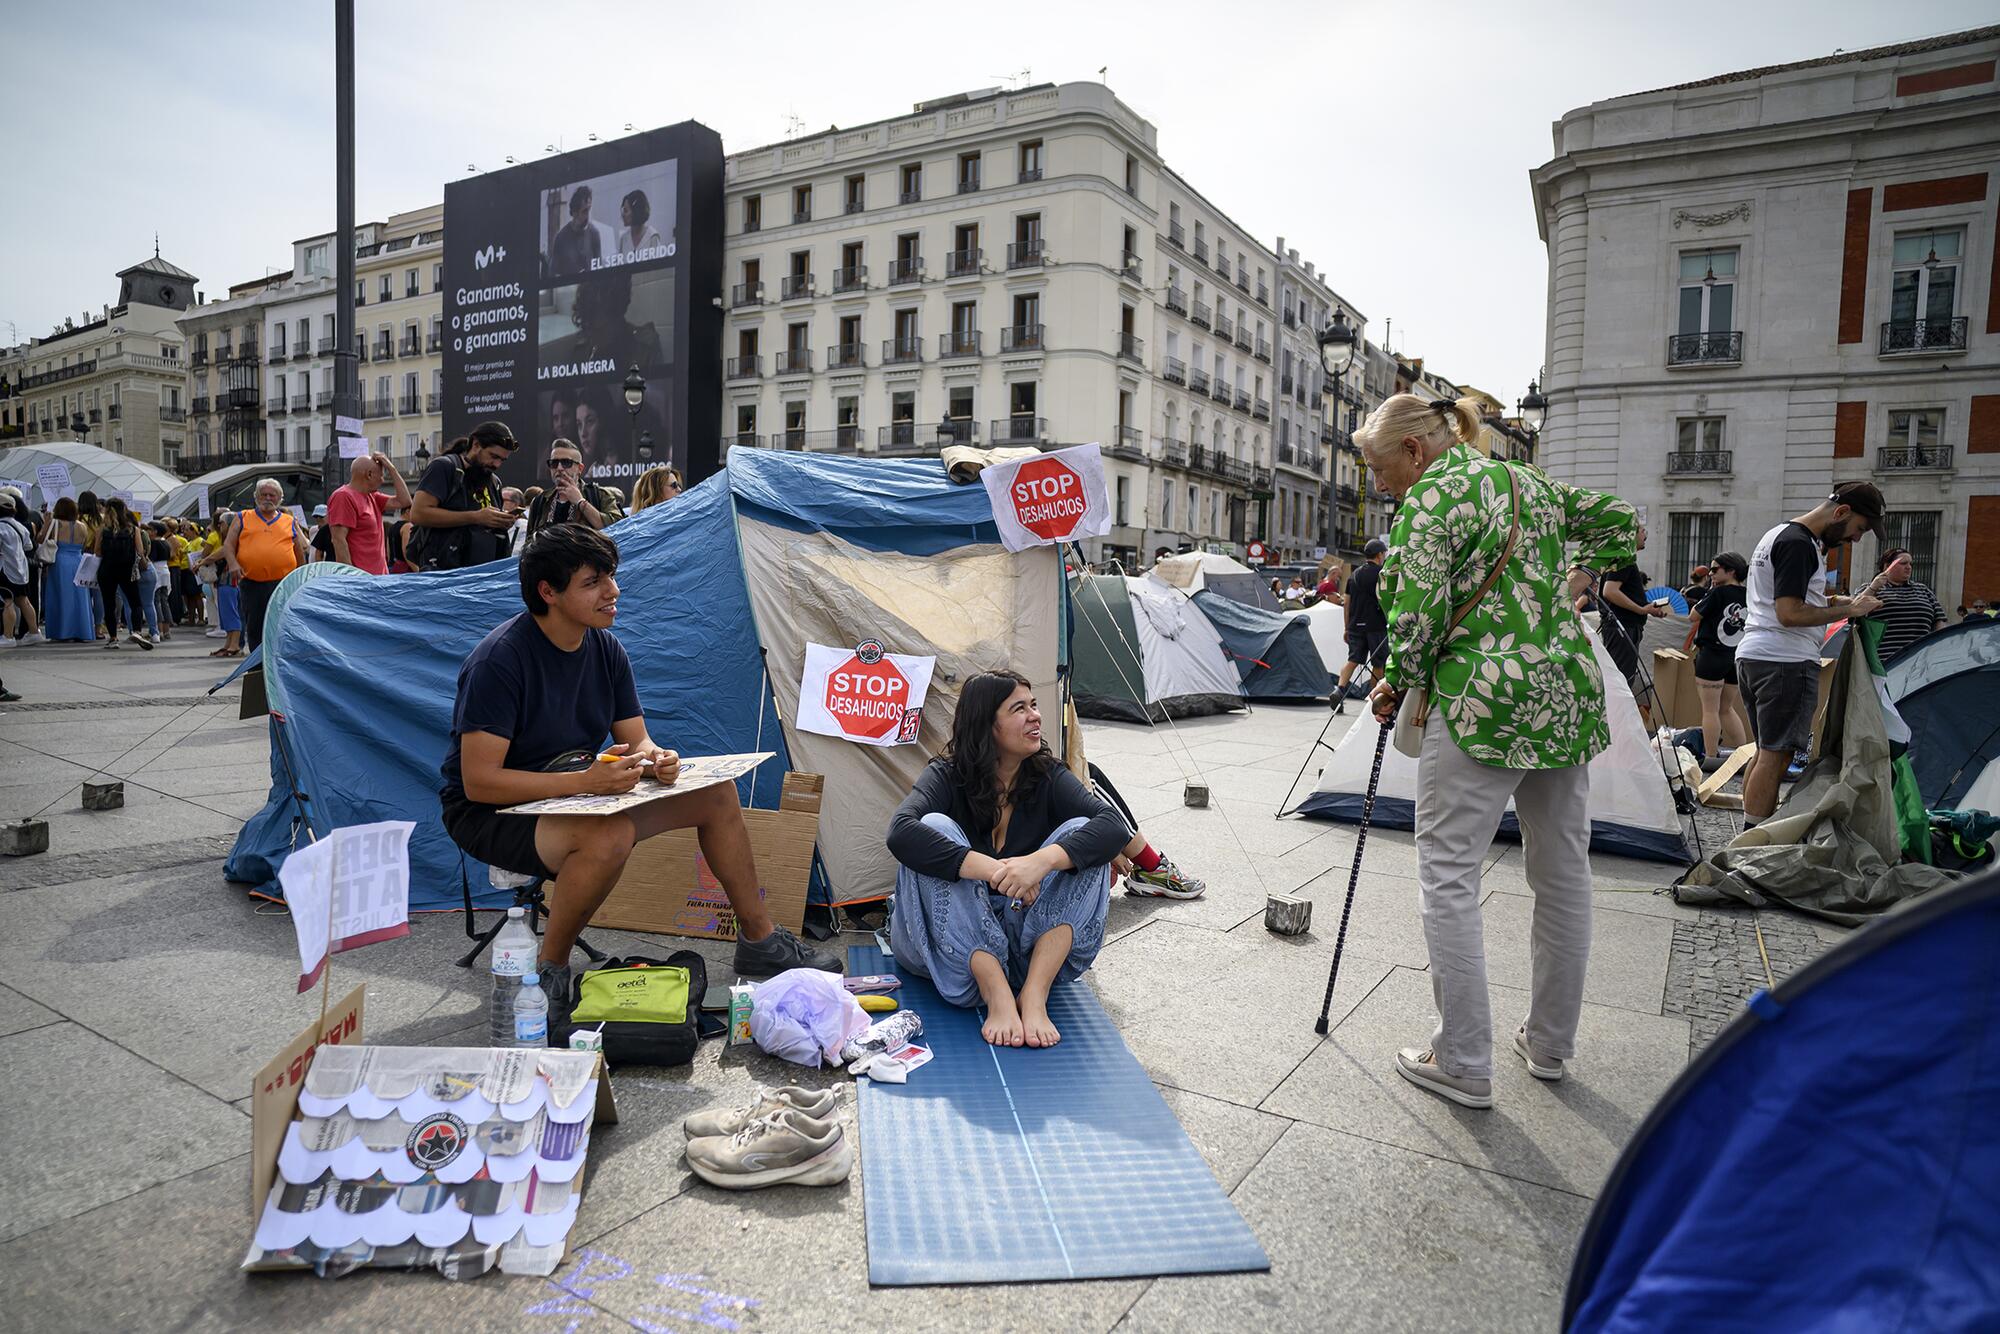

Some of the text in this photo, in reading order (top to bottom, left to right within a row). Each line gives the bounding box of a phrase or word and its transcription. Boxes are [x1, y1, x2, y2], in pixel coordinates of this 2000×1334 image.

[590, 243, 677, 271] EL SER QUERIDO
[456, 282, 524, 306] Ganamos,
[452, 305, 528, 332] o ganamos,
[454, 328, 527, 354] o ganamos
[485, 360, 504, 370] premio
[537, 359, 615, 380] LA BOLA NEGRA
[475, 404, 497, 413] Movistar
[592, 464, 611, 478] LOS
[1015, 474, 1074, 503] STOP
[1020, 496, 1084, 525] DESAHUCIOS
[833, 672, 903, 697] STOP
[830, 694, 904, 721] DESAHUCIOS
